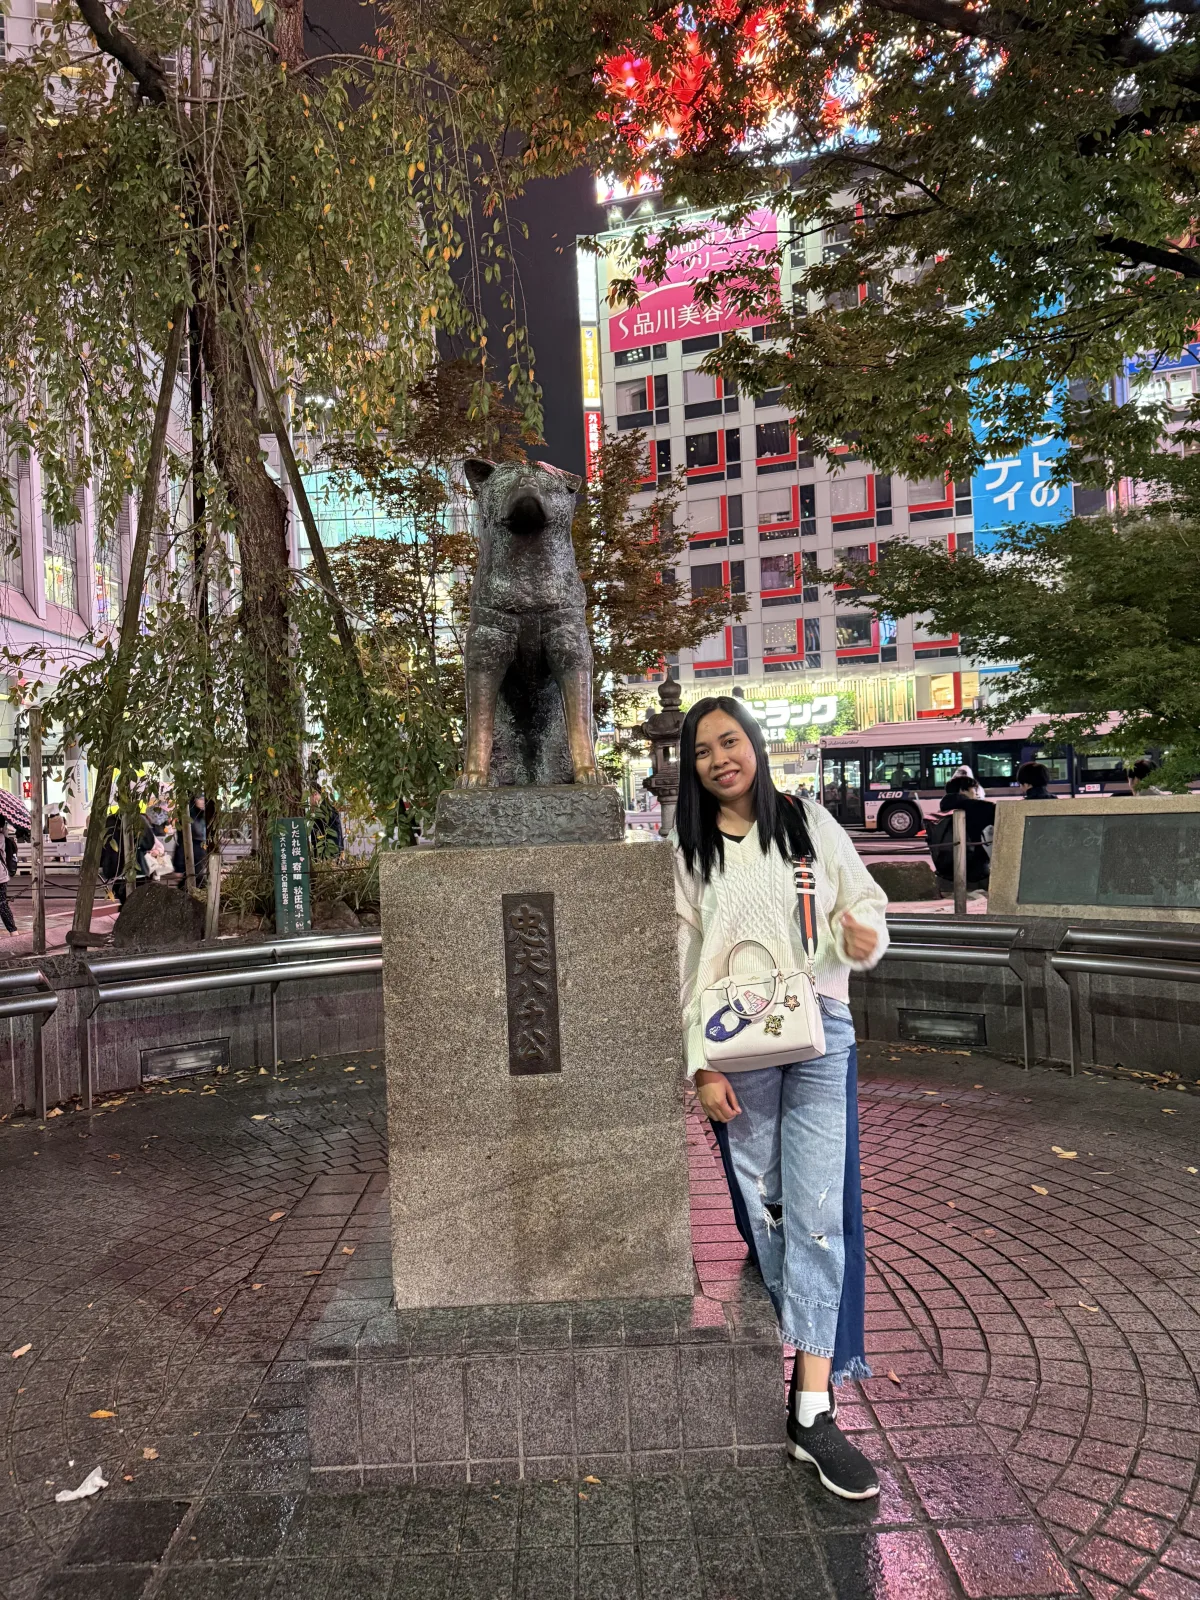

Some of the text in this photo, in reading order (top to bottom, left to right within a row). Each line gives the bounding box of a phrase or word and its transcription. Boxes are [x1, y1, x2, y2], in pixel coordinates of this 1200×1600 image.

[877, 791, 903, 799] KEIO
[291, 821, 302, 857] しだれ桜
[505, 905, 550, 1061] 忠犬ハチ公
